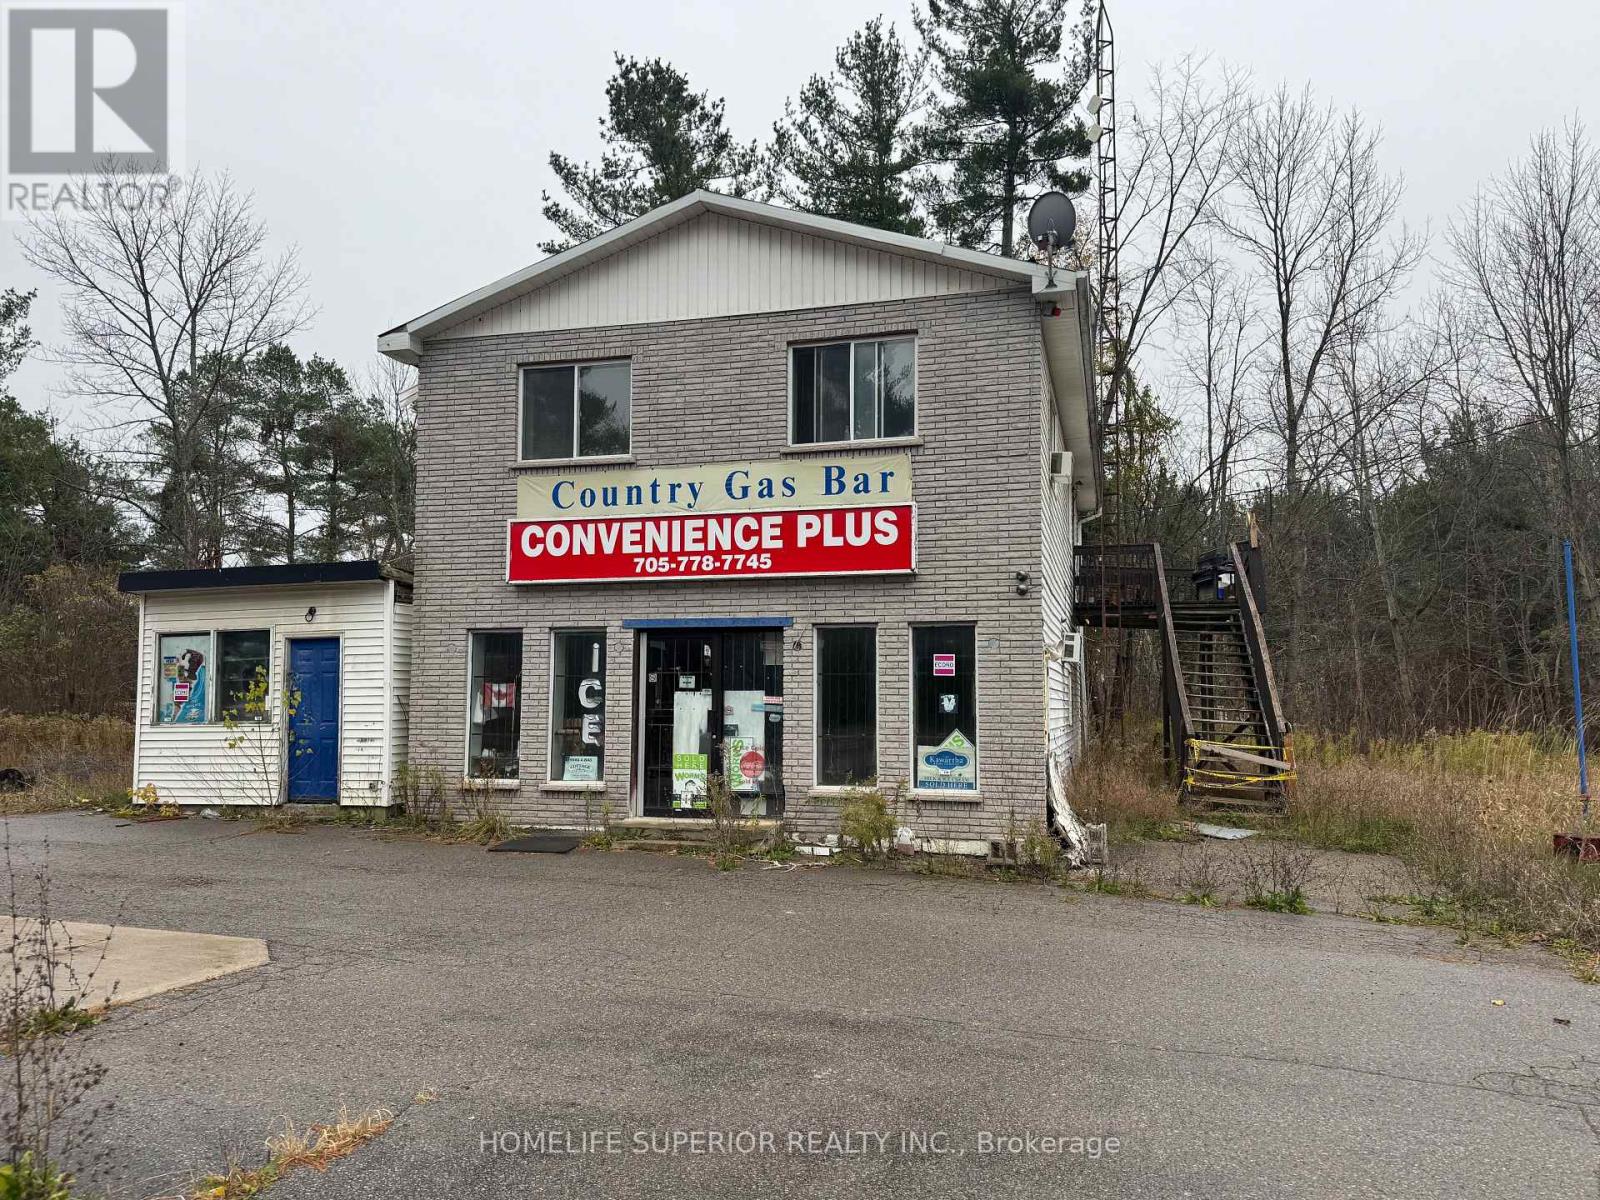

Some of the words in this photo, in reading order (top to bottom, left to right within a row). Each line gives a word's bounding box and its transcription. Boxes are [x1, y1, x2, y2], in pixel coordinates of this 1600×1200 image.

[552, 478, 704, 510] Country
[725, 470, 796, 500] Gas
[822, 465, 895, 496] Bar
[521, 515, 784, 558] CONVENIENCE
[797, 510, 899, 548] PLUS
[633, 553, 772, 574] 705-778-7745
[676, 754, 705, 762] SOLD
